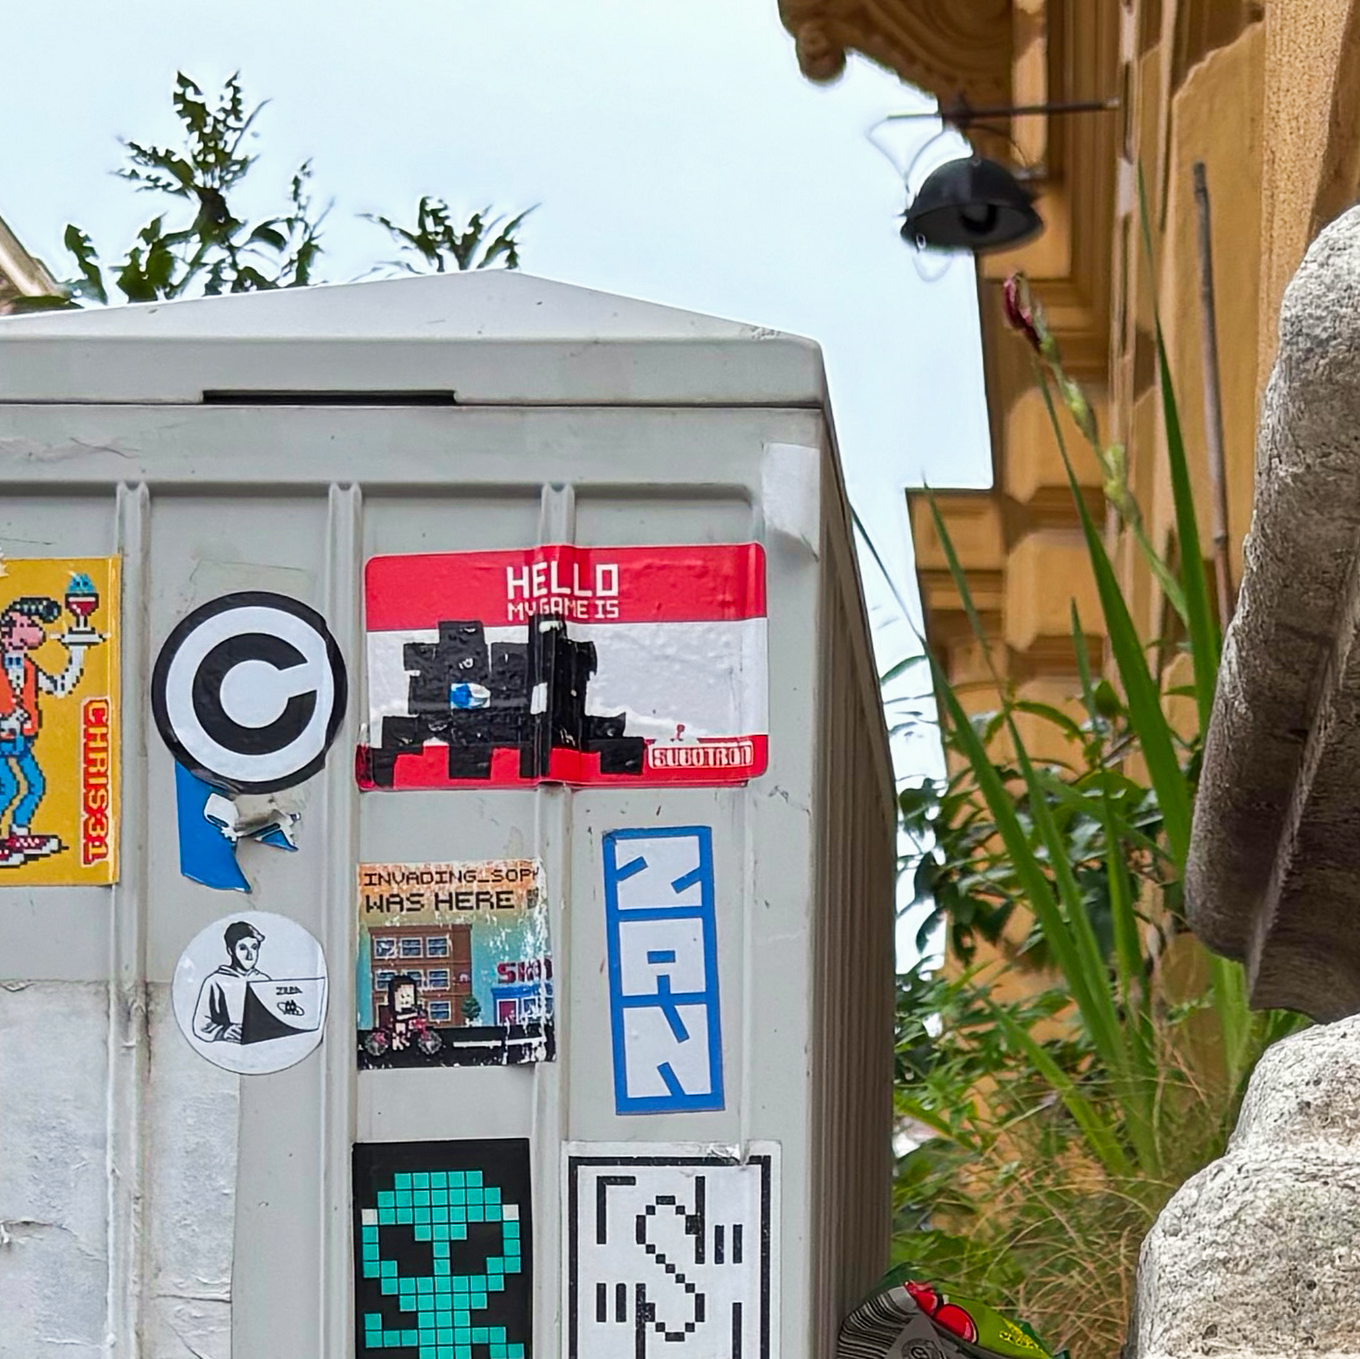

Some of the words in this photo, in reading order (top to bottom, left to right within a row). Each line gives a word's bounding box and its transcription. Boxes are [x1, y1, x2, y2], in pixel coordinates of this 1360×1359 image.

[506, 561, 619, 600] HELLO
[507, 600, 537, 621] MY
[539, 597, 589, 619] GAME
[594, 599, 619, 619] IS
[365, 892, 426, 914] WAS
[433, 889, 516, 912] HERE
